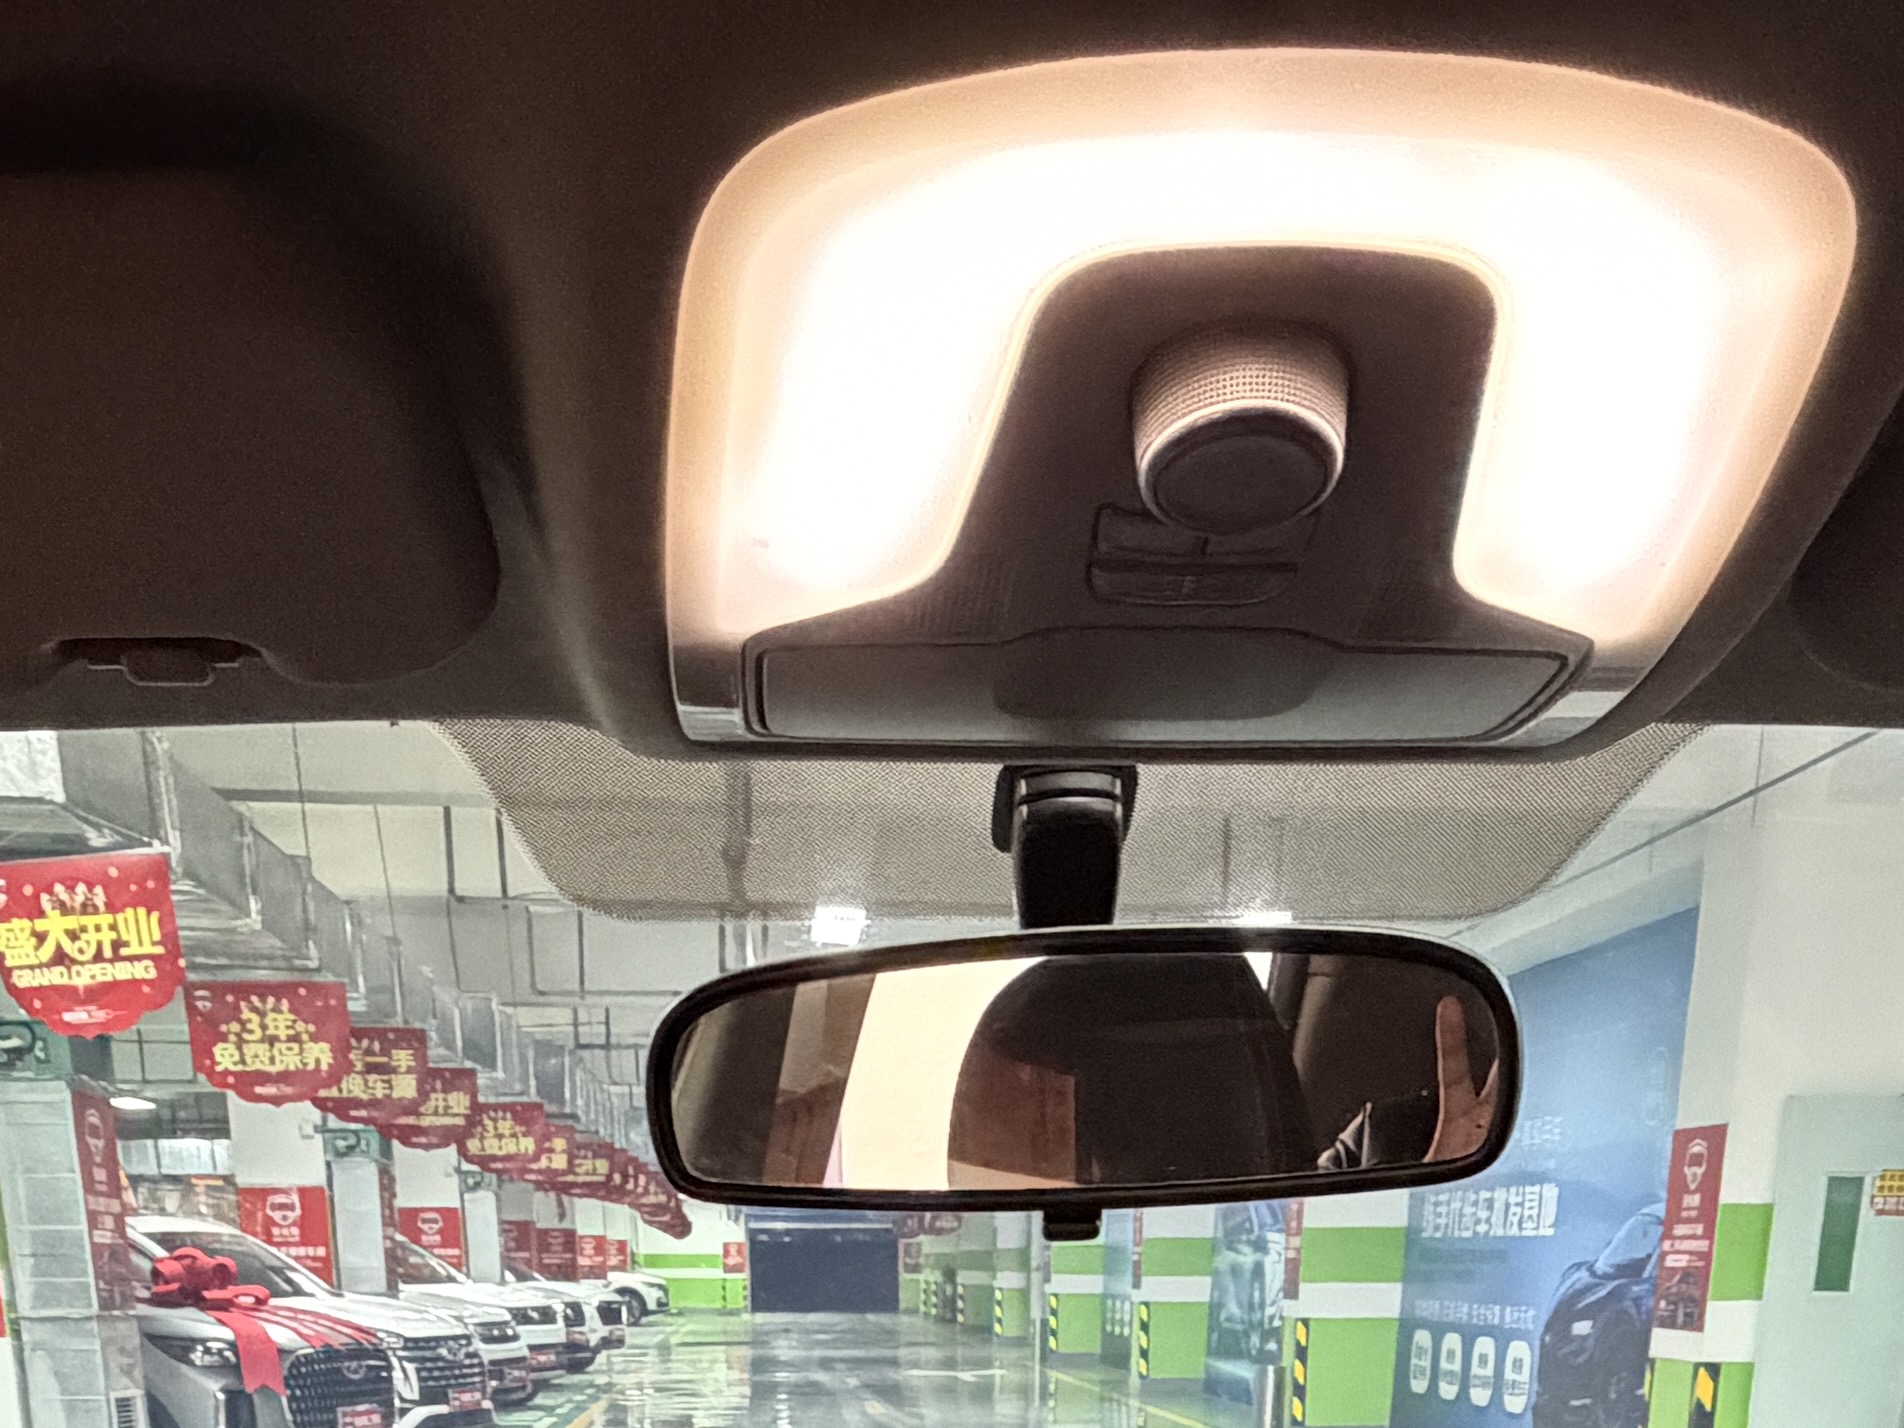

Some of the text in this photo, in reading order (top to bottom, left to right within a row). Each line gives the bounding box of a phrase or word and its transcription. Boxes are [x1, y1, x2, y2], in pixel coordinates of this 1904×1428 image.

[11, 959, 158, 988] GRAND OPENING
[242, 1012, 296, 1041] 3年
[212, 1041, 334, 1073] 免费保养
